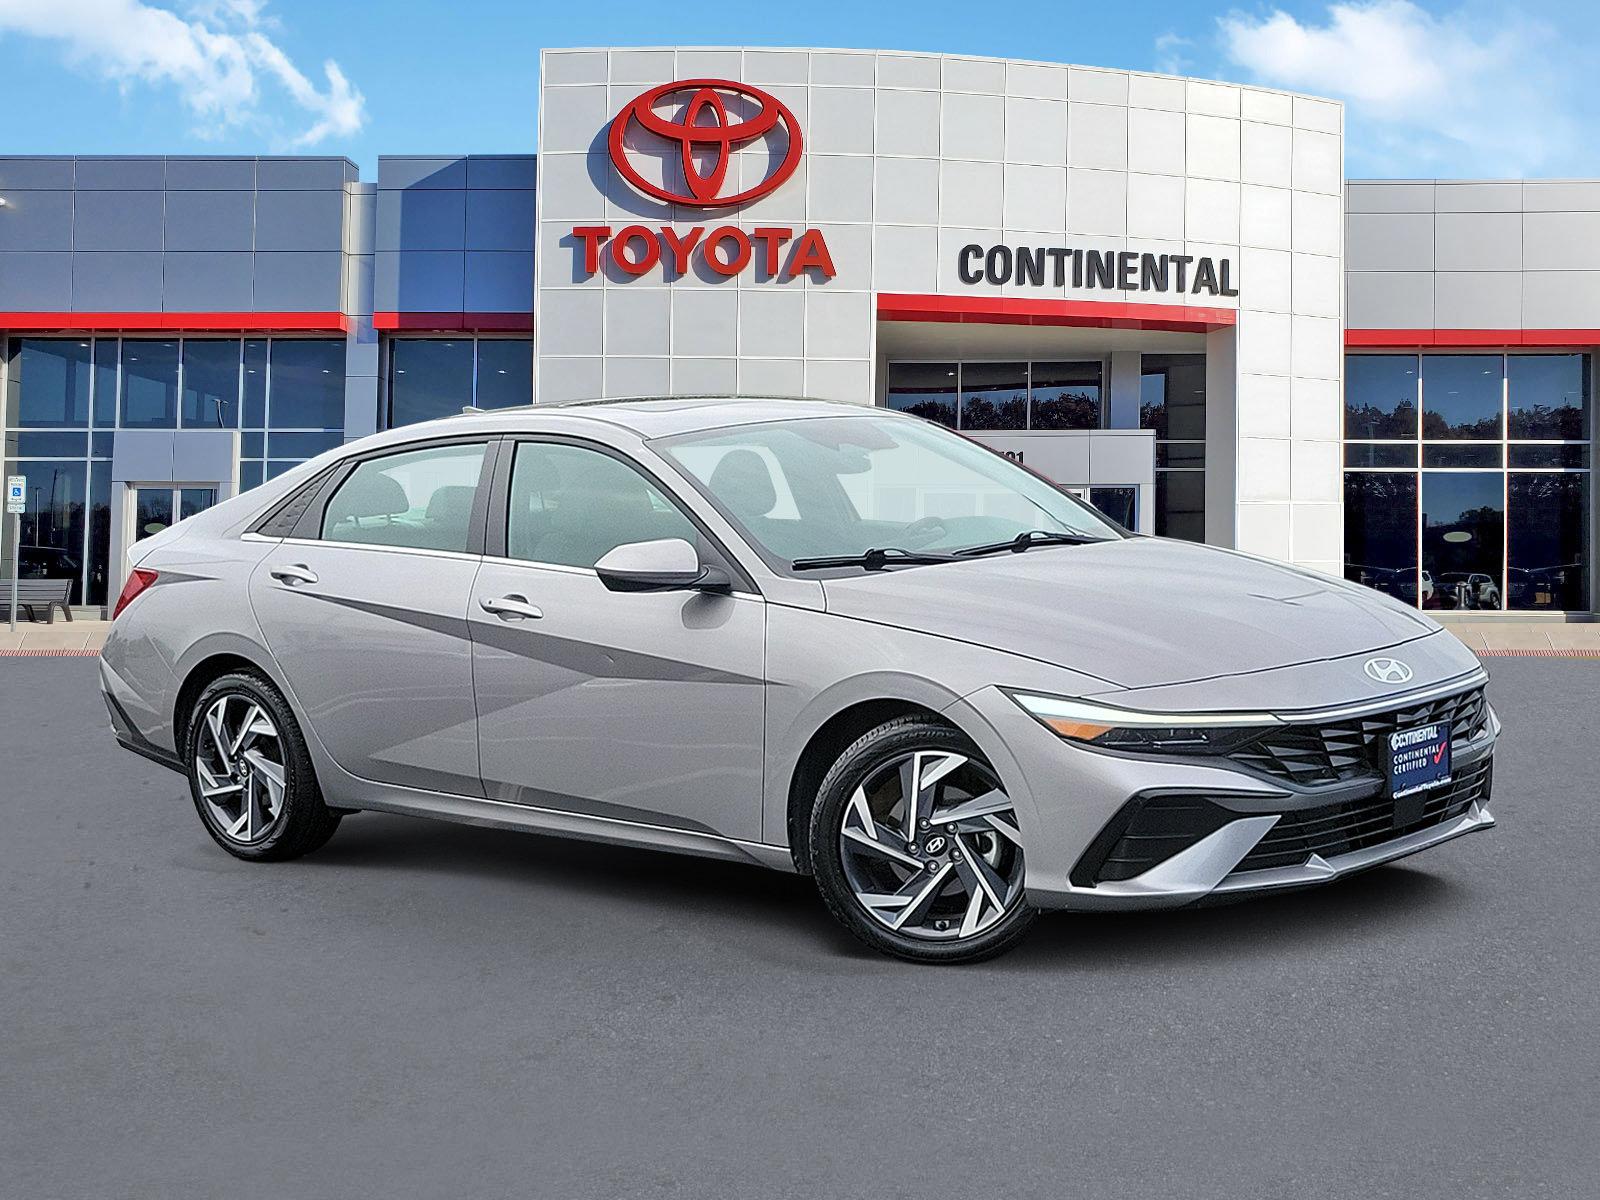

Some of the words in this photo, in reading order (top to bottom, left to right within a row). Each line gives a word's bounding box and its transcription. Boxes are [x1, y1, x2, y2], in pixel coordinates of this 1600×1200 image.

[573, 225, 837, 277] TOYOTA
[958, 244, 1239, 296] CONTINENTAL
[1393, 744, 1439, 765] CONTINENTAL
[1393, 757, 1427, 775] CERTIFIED
